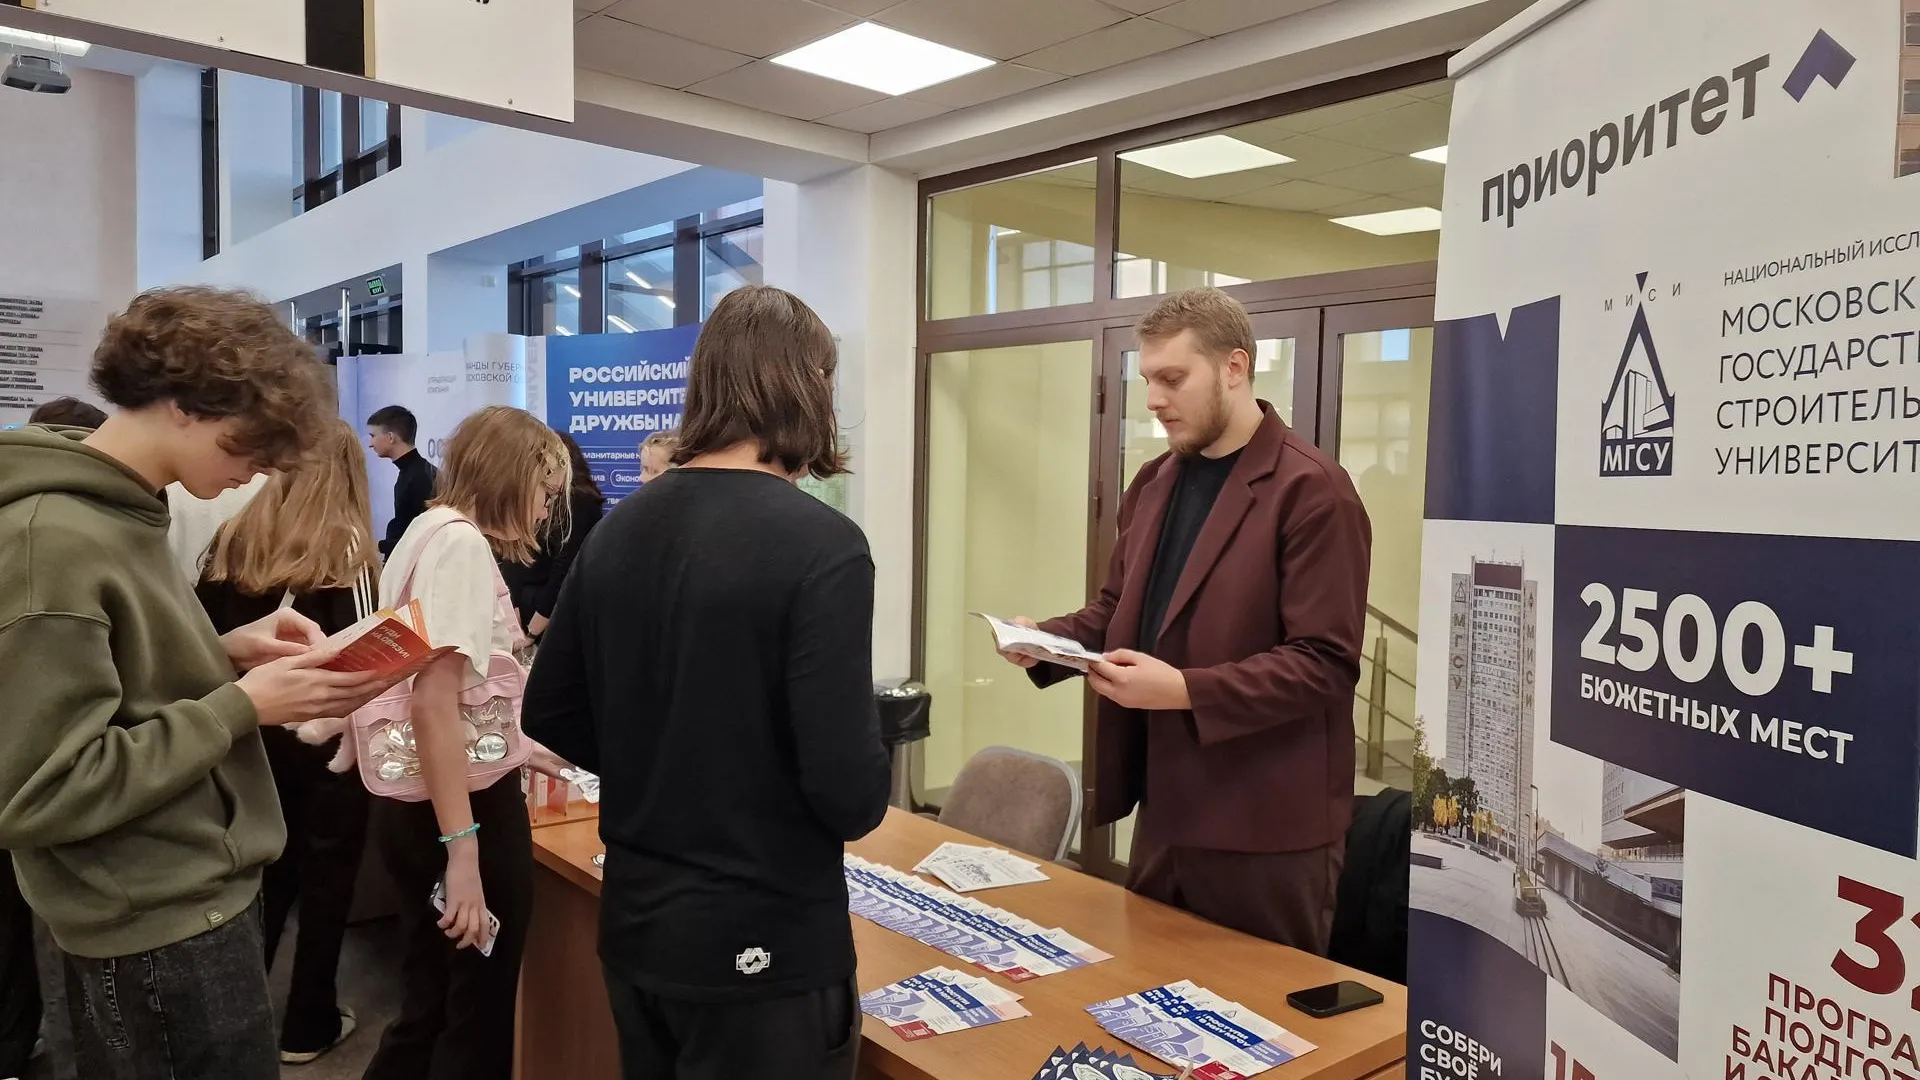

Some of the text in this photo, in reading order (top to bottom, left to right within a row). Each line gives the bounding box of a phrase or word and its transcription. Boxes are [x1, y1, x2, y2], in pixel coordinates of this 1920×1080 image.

[1482, 54, 1770, 228] приоритет
[1724, 239, 1864, 286] НАЦИОНАЛЬНЫЙ
[1721, 276, 1917, 338] МОСКОВСК
[1719, 330, 1920, 384] ГОСУДАРСТ
[568, 414, 659, 434] ДРУЖБЫ
[1716, 386, 1920, 429] СТРОИТЕЛЬ
[1603, 442, 1670, 472] МГСУ
[1715, 440, 1920, 475] УНИВЕРСИТ
[1580, 582, 1854, 696] 2500+
[1580, 673, 1854, 765] БЮЖЕТНЫХ МЕСТ
[1830, 875, 1920, 1013] 3
[1420, 1019, 1502, 1077] СОБЕРИ
[1768, 972, 1920, 1072] ПРОГРА
[1420, 1044, 1479, 1080] СВОЁ
[1732, 1023, 1841, 1080] БАКА
